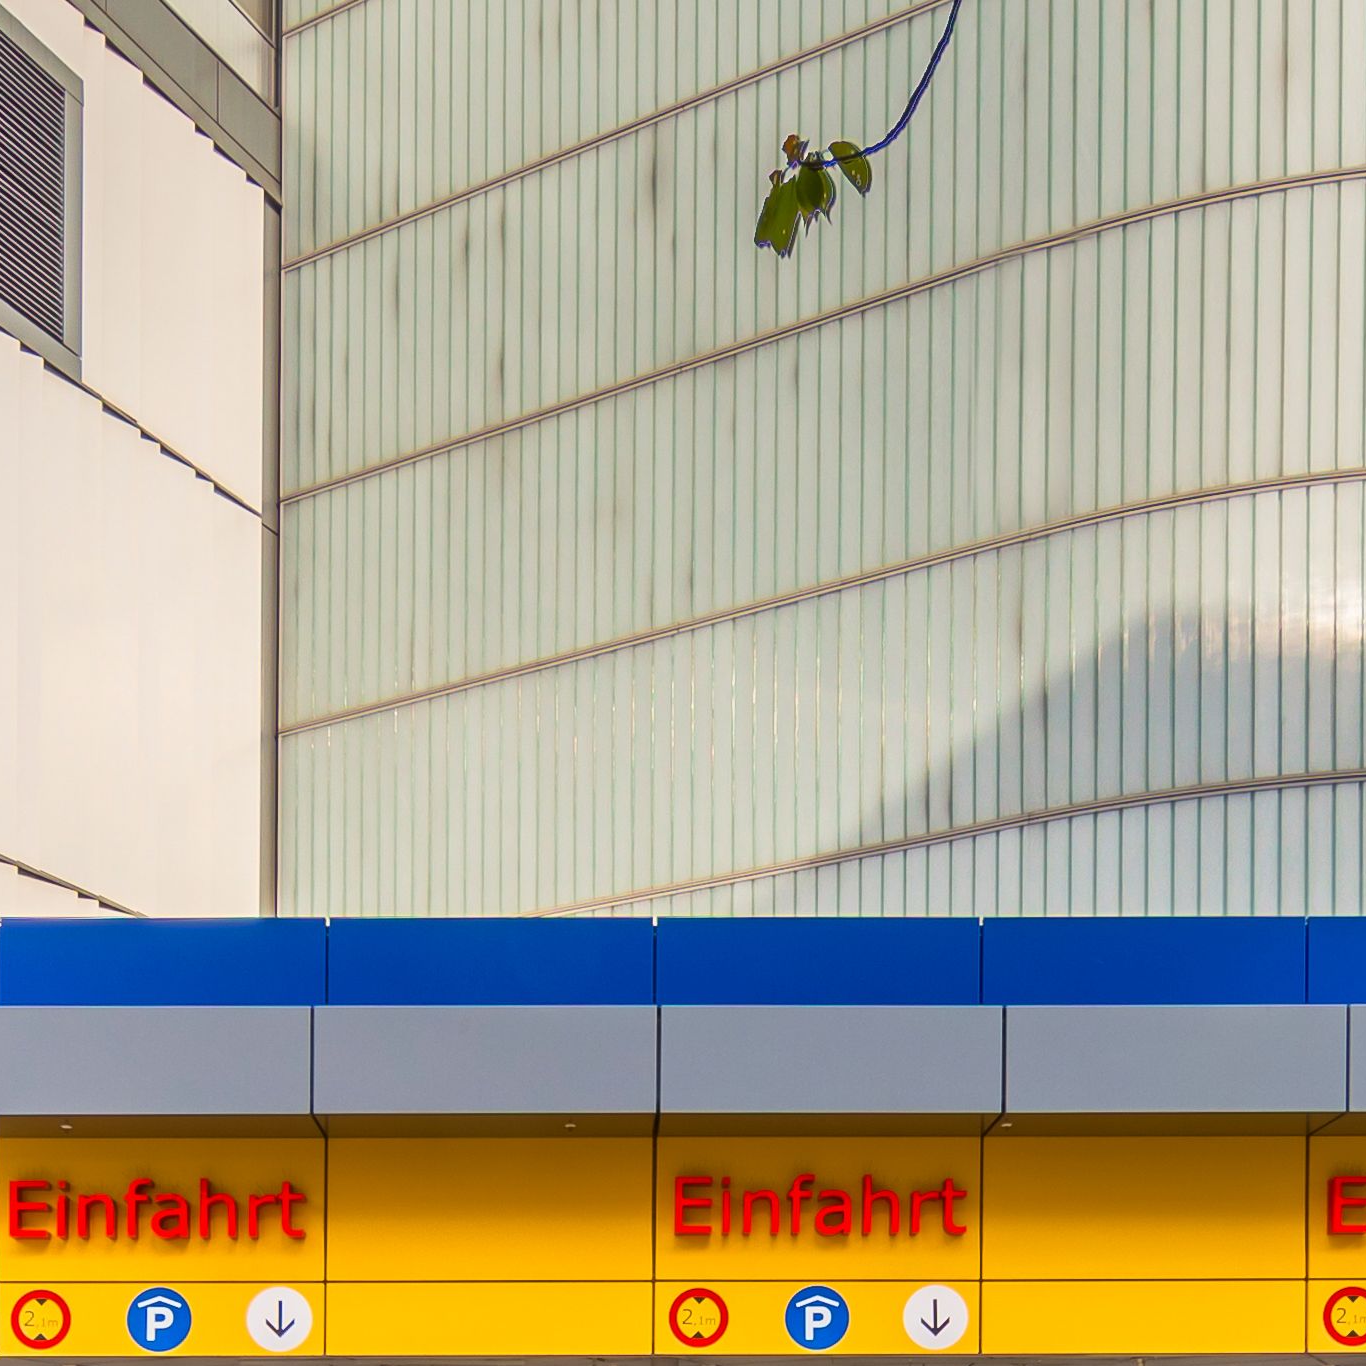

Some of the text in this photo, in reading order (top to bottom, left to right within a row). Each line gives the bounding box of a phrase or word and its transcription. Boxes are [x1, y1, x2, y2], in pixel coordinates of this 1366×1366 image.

[8, 1177, 306, 1240] Einfahrt
[674, 1173, 968, 1237] Einfahrt
[146, 1307, 174, 1342] P
[805, 1306, 833, 1341] P
